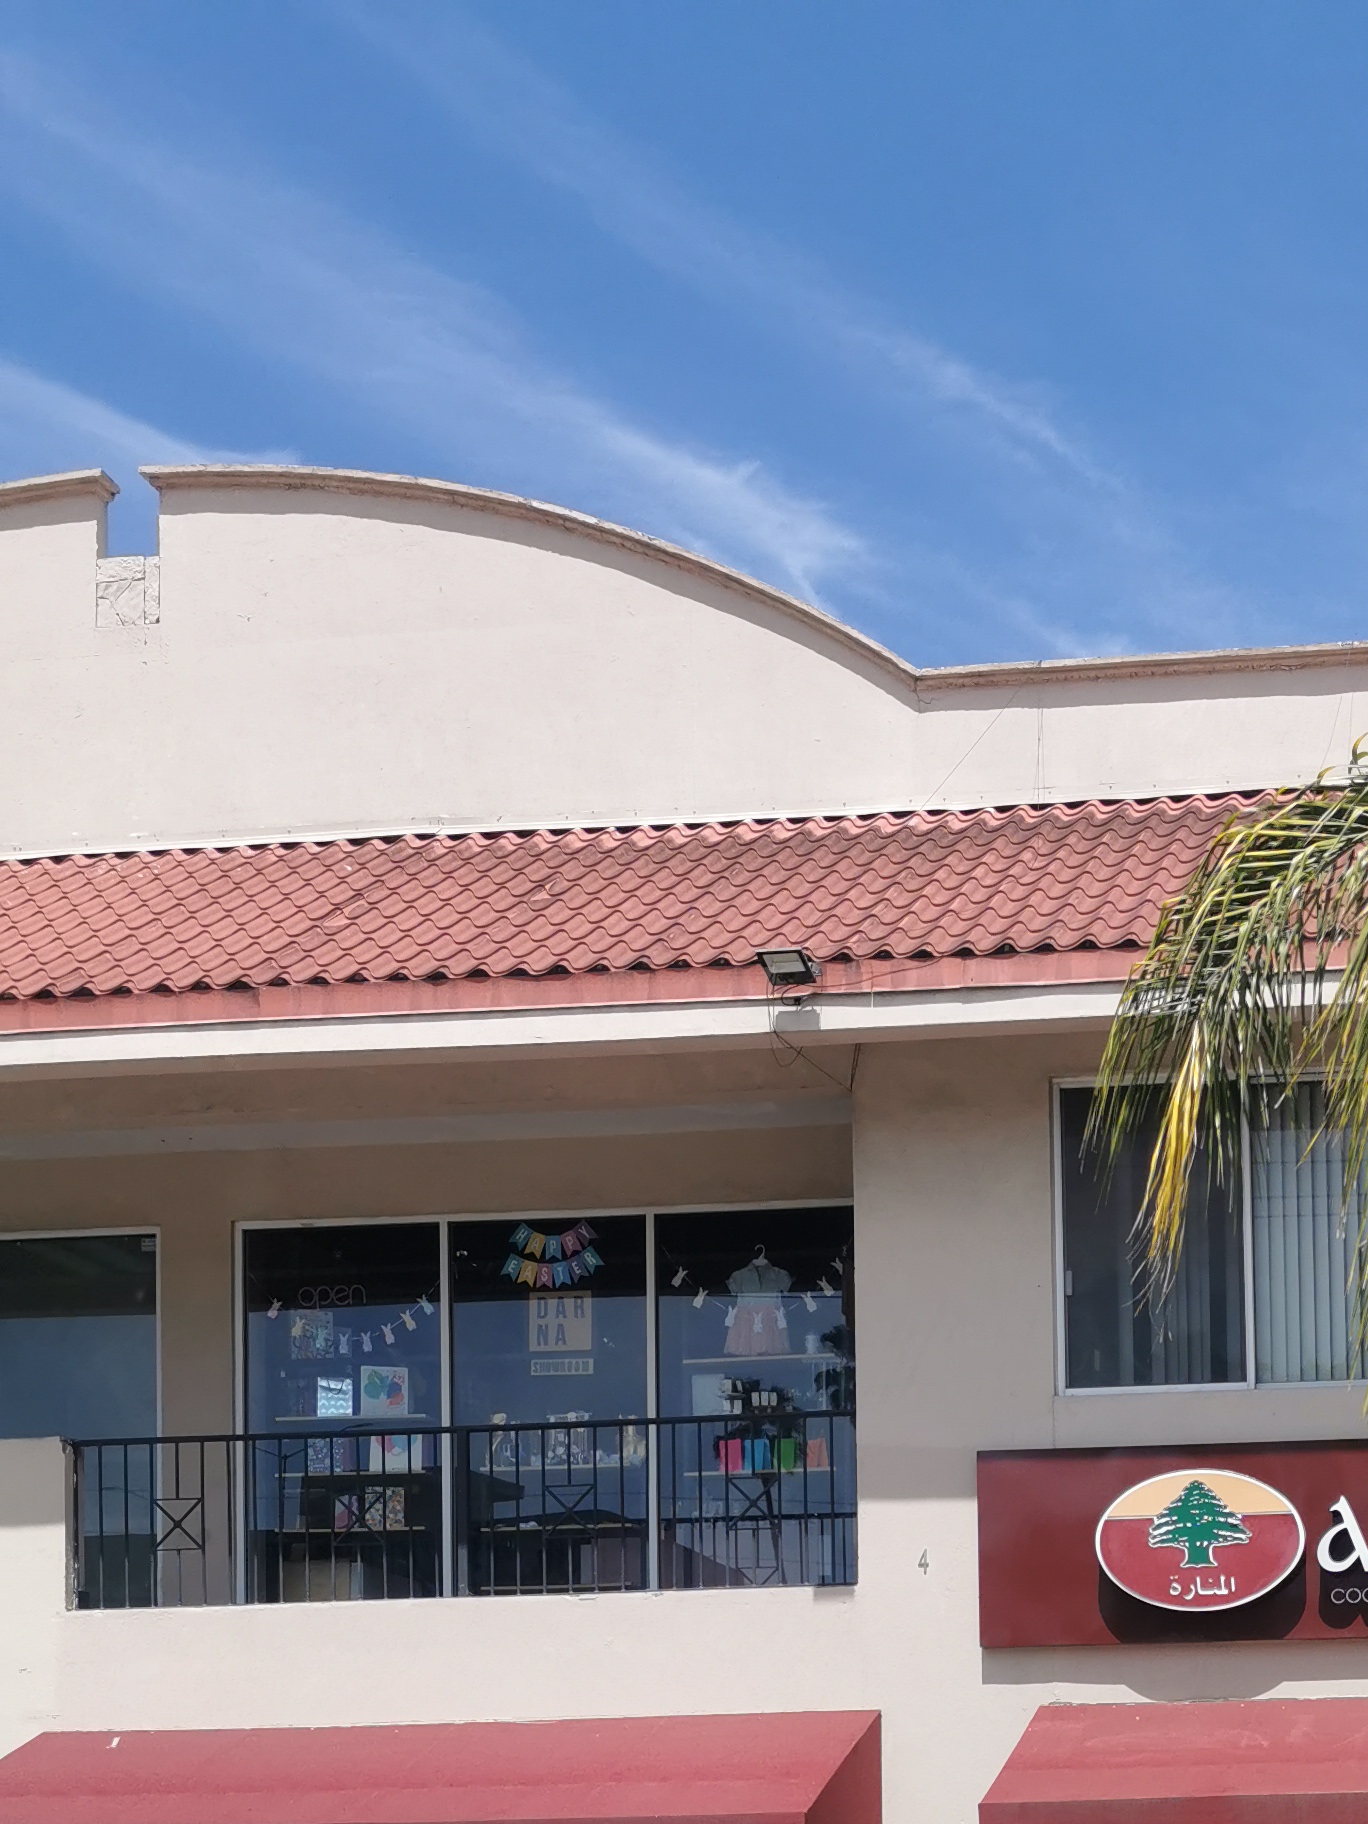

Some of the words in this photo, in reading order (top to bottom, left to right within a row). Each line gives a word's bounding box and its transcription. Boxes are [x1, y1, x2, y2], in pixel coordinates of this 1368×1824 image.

[515, 1225, 591, 1253] HAPPY
[507, 1251, 597, 1282] EASTER
[298, 1284, 367, 1312] open
[536, 1295, 586, 1320] DAR
[536, 1323, 568, 1347] NA
[918, 1548, 930, 1576] 4
[1169, 1573, 1236, 1601] المنارة
